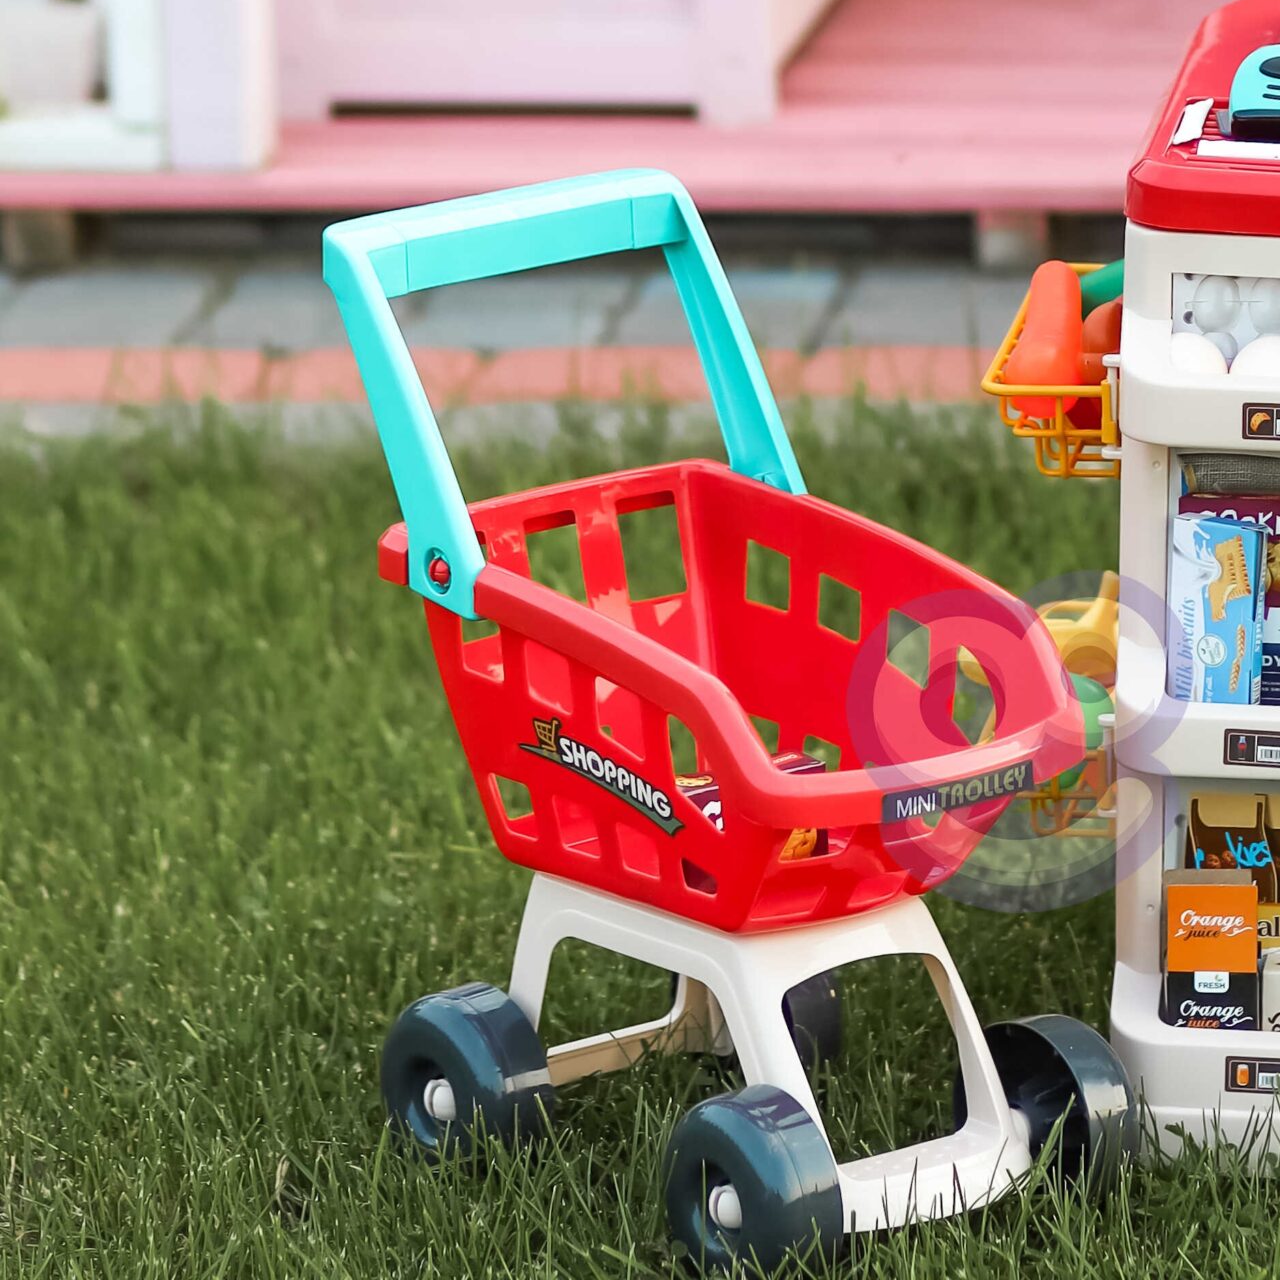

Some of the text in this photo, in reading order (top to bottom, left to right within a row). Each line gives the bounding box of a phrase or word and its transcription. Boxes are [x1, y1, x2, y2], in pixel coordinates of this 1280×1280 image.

[1175, 597, 1195, 699] Milk biscuits
[558, 736, 672, 819] SHOPPING
[896, 765, 1026, 819] MINI TROLLEY
[1180, 909, 1245, 932] Orange
[1183, 927, 1220, 941] juice
[1179, 999, 1244, 1023] Orange
[1186, 1017, 1220, 1028] juice
